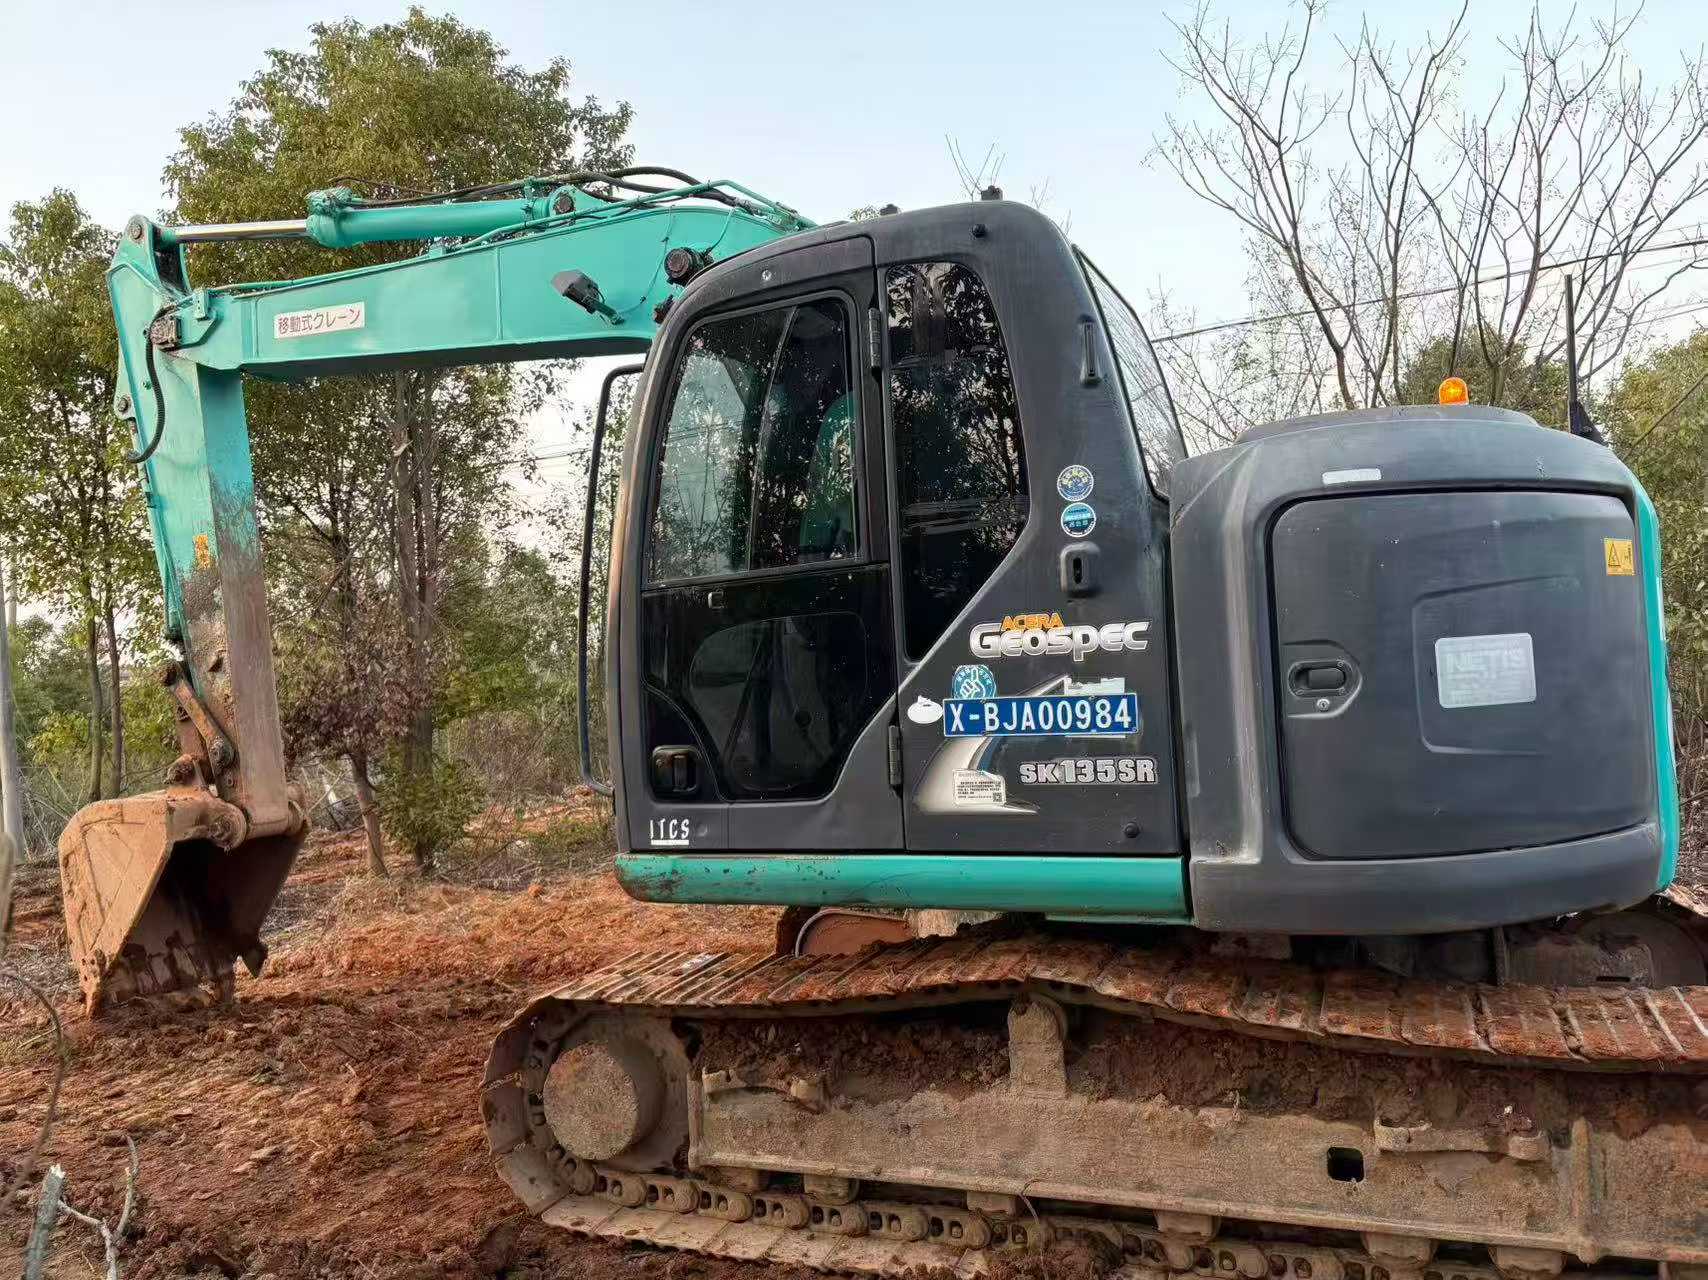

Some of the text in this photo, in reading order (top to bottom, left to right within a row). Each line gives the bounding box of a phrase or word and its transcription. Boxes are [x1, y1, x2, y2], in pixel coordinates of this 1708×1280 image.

[278, 307, 361, 335] 移動式クレーン
[1001, 612, 1064, 631] ACERA
[950, 698, 1132, 732] X-BJA00984
[1019, 759, 1156, 784] SK135SR
